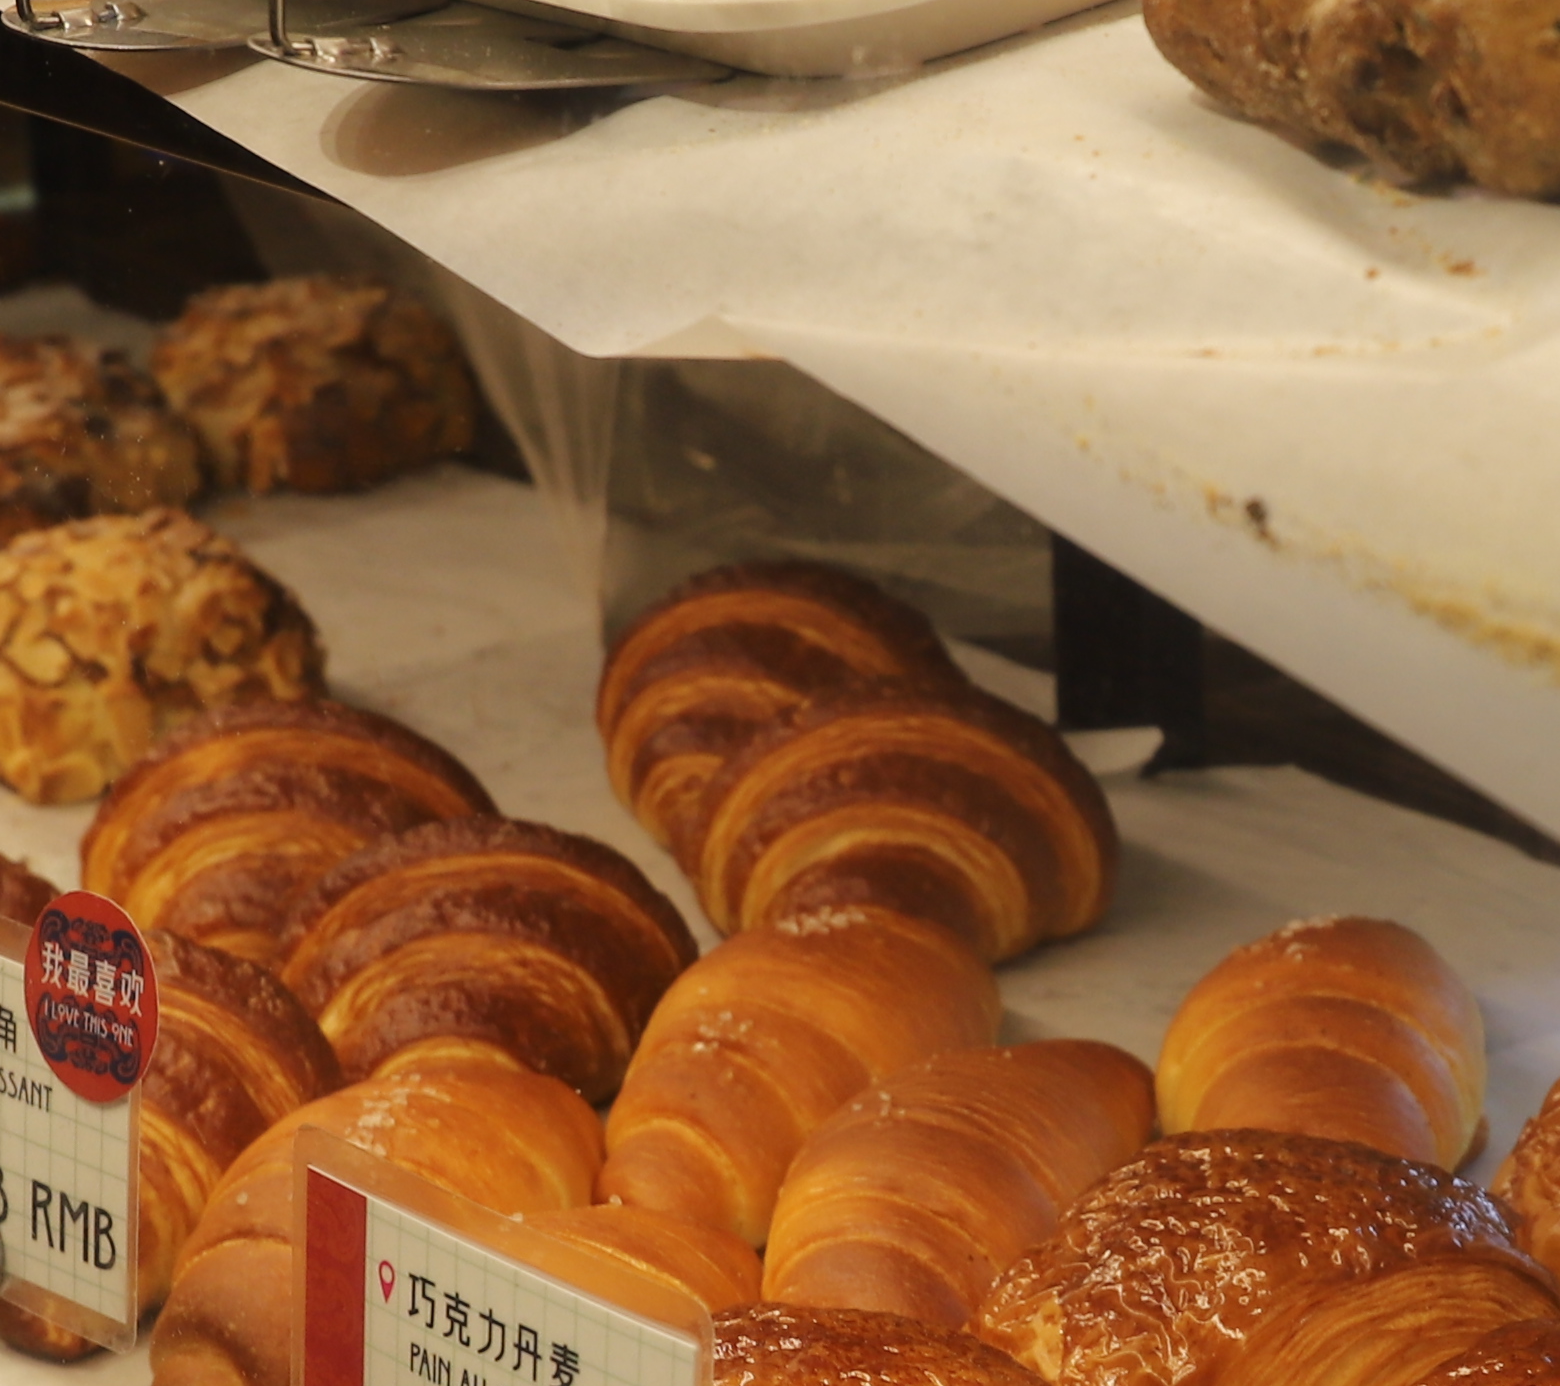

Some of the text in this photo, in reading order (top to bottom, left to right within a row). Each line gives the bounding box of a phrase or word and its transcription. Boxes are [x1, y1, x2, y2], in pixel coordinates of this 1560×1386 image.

[41, 940, 145, 1018] 我最喜欢
[51, 1001, 81, 1029] LOVE
[82, 1011, 109, 1038] THIS
[111, 1021, 135, 1048] ONE
[31, 1179, 116, 1270] RMB
